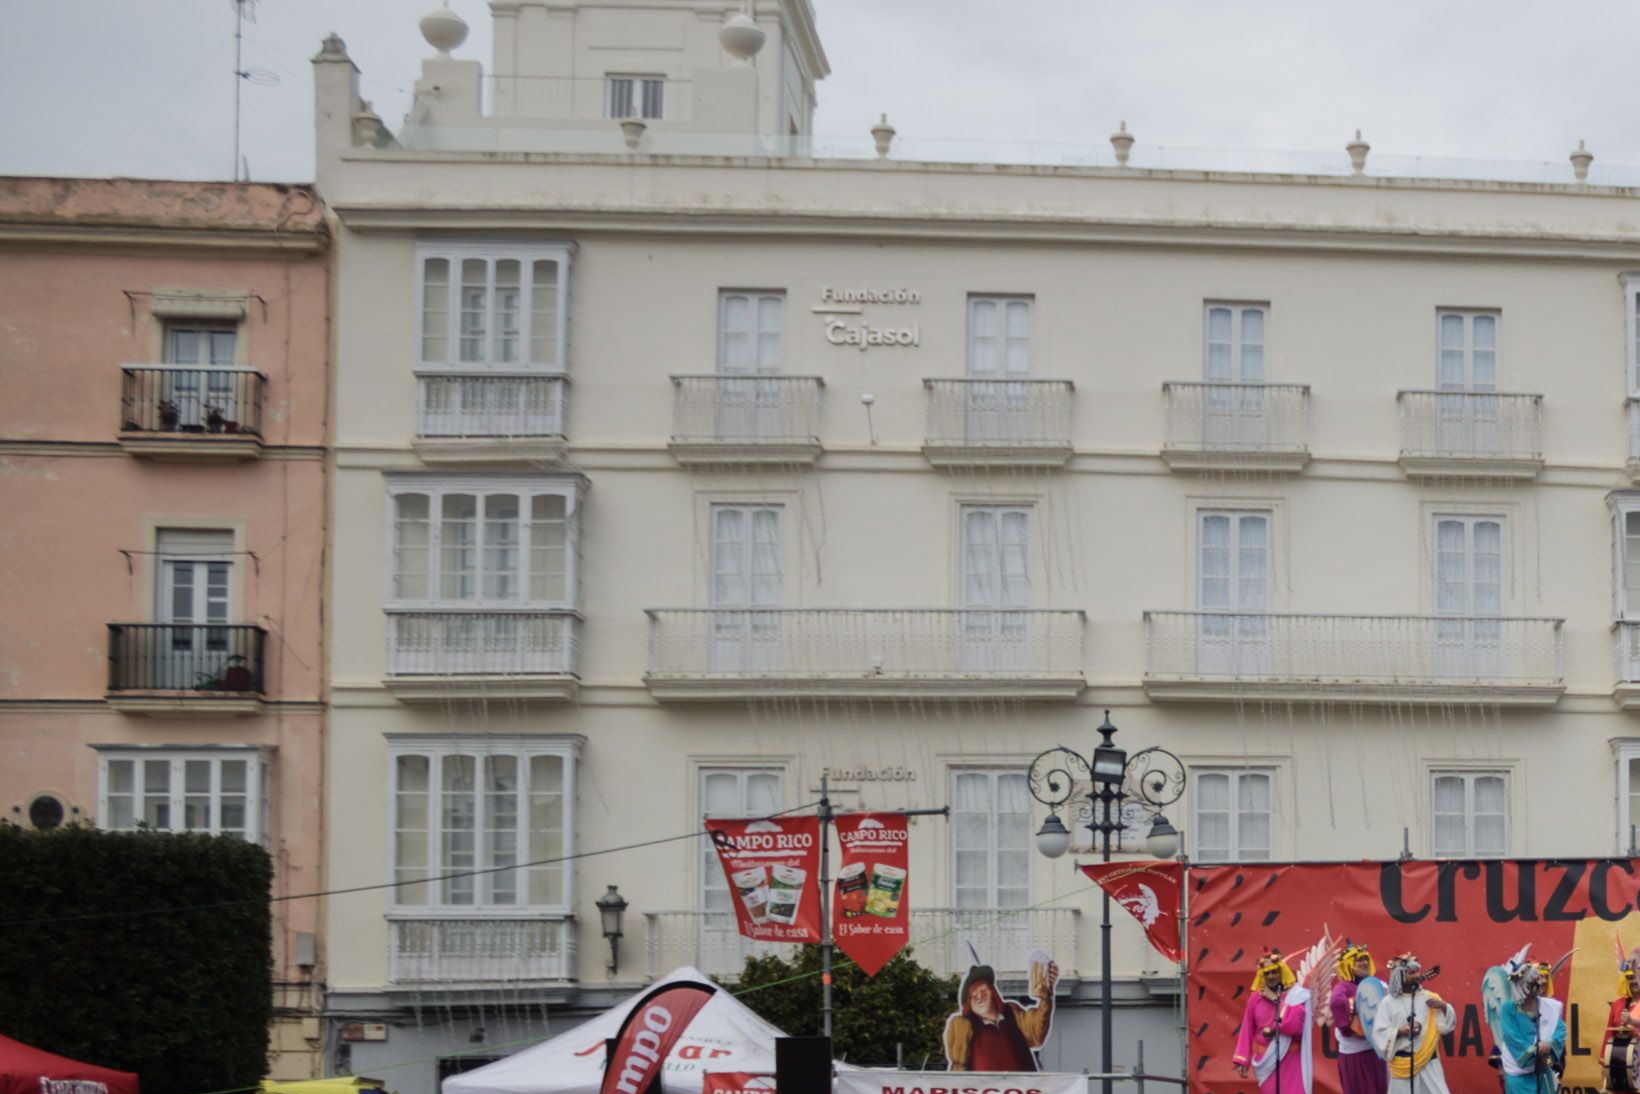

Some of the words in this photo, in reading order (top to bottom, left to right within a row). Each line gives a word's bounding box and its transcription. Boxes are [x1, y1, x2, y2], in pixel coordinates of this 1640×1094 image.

[822, 286, 920, 304] Fundación
[825, 319, 920, 351] Cajasol
[822, 765, 916, 781] Fundación
[776, 833, 812, 849] RICO
[840, 829, 877, 843] CAMPO
[878, 829, 908, 841] RICO
[786, 927, 809, 938] casa
[838, 923, 848, 936] El
[849, 922, 871, 936] Sabor
[872, 923, 883, 935] de
[884, 926, 904, 935] casa
